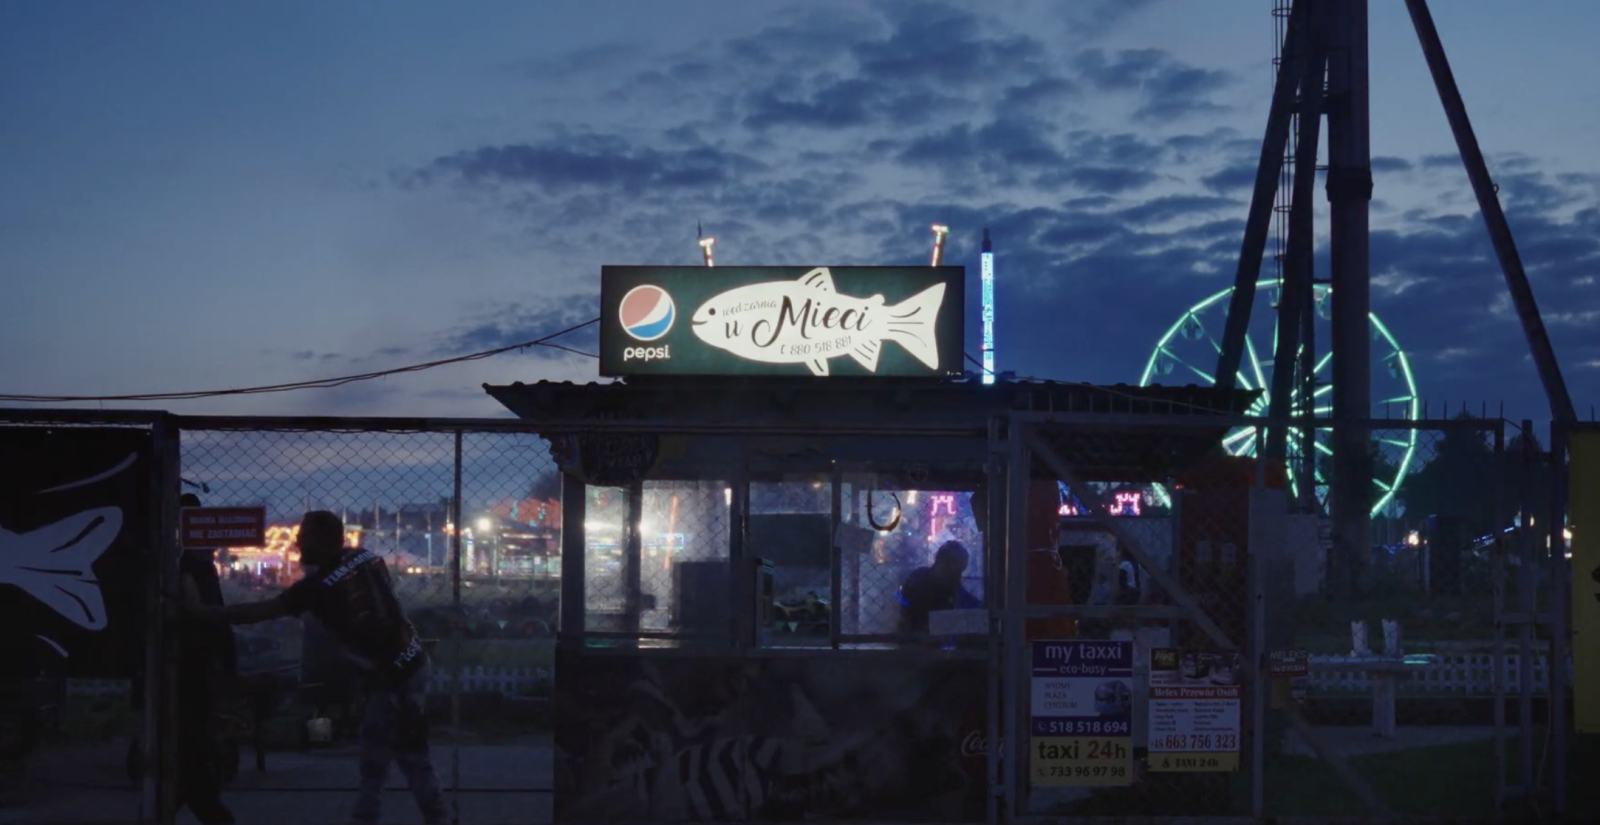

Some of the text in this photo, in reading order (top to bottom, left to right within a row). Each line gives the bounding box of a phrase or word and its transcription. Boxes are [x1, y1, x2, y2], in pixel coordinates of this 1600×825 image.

[725, 295, 873, 348] u Mieci
[790, 335, 852, 355] 880 518 881
[624, 345, 671, 361] pepsi
[190, 529, 204, 538] NIE
[1045, 643, 1122, 663] my taxxi
[1059, 663, 1106, 675] eco-busy
[1049, 721, 1128, 733] 518 518 694
[1166, 734, 1187, 749] 663
[1190, 734, 1211, 749] 756
[1215, 734, 1236, 749] 323
[1038, 740, 1079, 759] taxi
[1175, 759, 1196, 767] TAXI
[1050, 766, 1125, 777] 733 96 97 98
